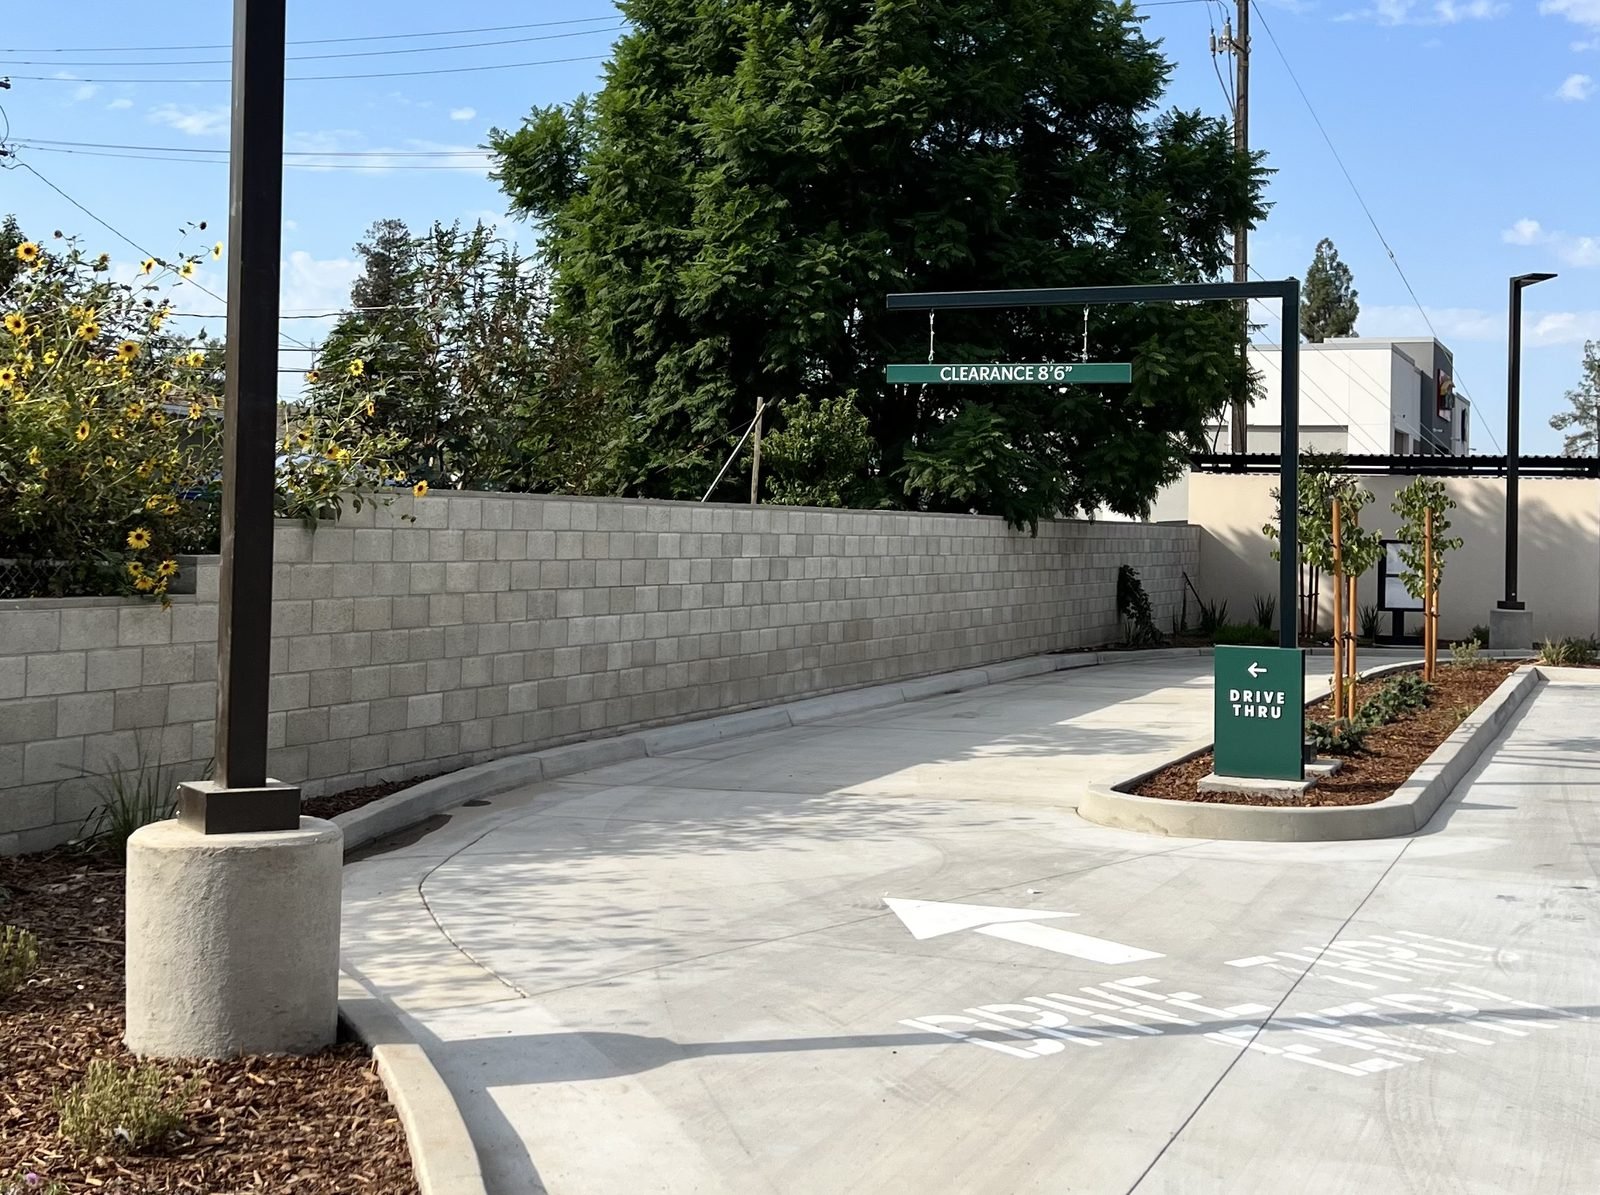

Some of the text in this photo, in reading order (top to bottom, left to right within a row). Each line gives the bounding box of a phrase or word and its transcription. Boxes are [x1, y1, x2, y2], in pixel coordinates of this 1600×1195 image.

[940, 366, 1034, 382] CLEARANCE
[1229, 689, 1285, 705] DRIVE
[1232, 703, 1281, 719] THRU
[897, 976, 1273, 1059] DRIVE
